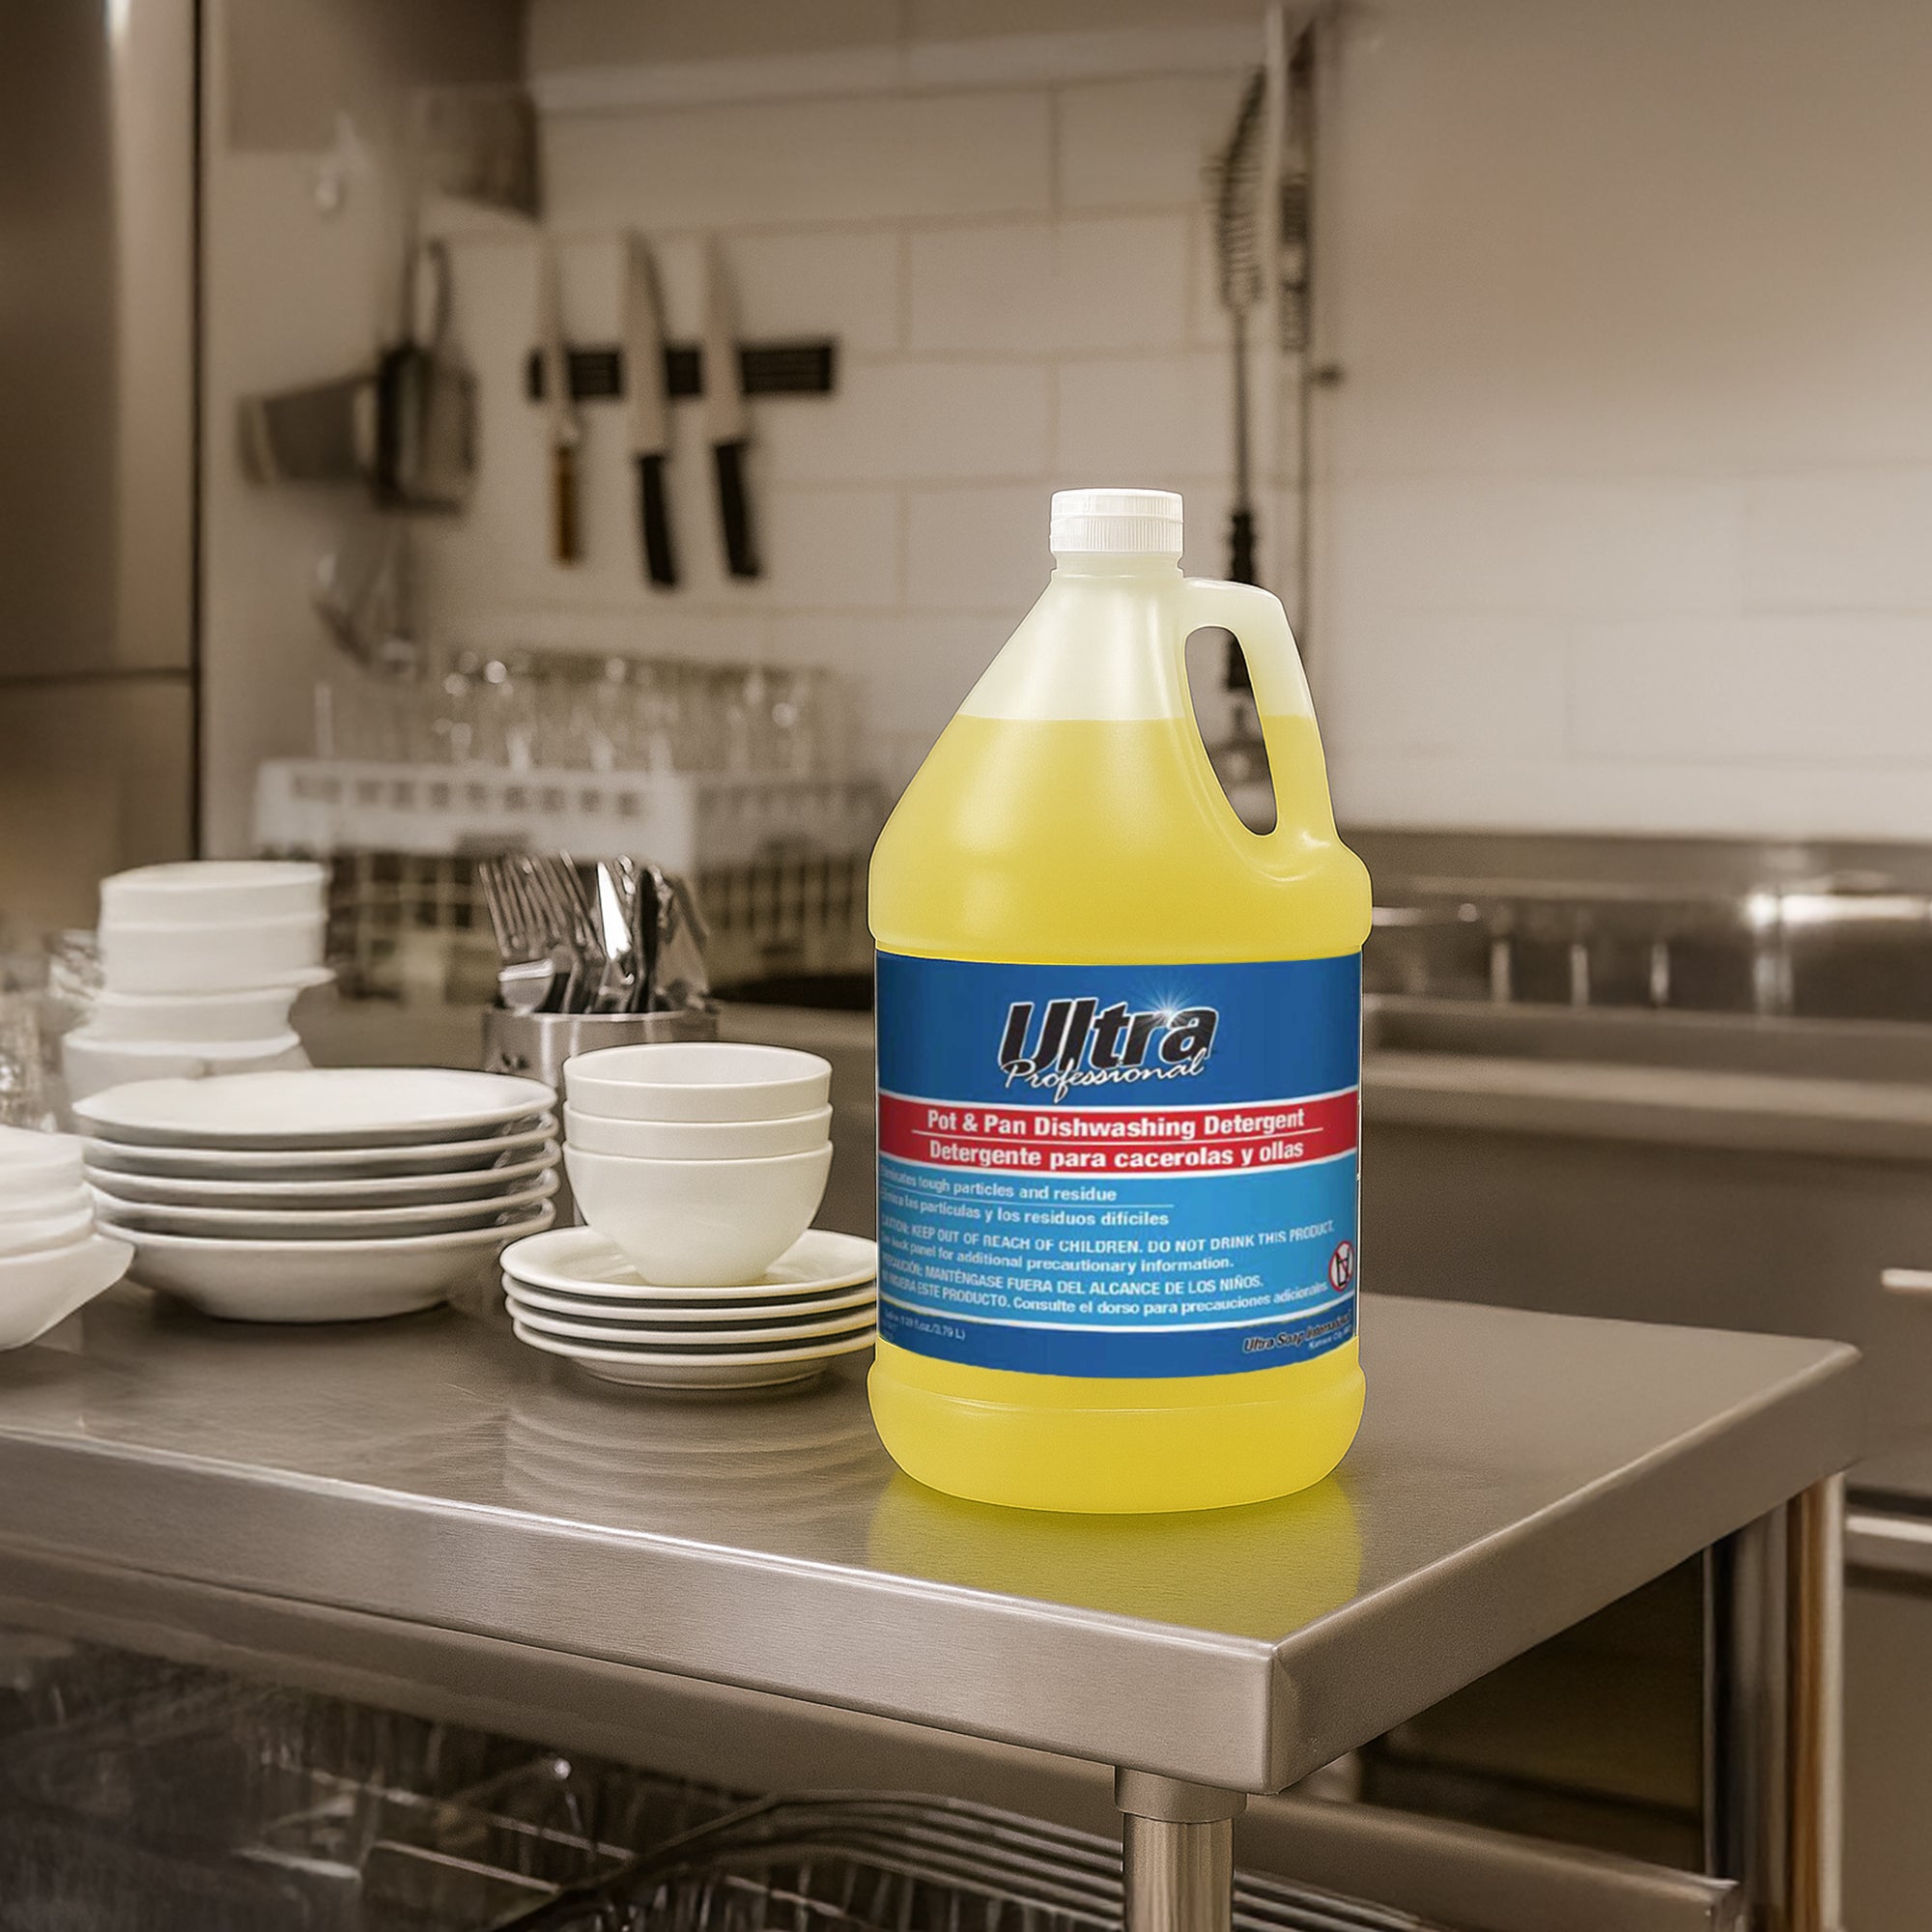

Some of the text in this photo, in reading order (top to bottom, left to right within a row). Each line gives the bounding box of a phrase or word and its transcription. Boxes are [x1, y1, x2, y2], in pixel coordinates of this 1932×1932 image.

[998, 997, 1219, 1074] Ultra
[1001, 1047, 1207, 1103] Professional
[927, 1108, 1304, 1140] Pot & Pan Dishwashing Detergent
[929, 1140, 1304, 1170] Detergente para cacerolas y ollas
[919, 1177, 950, 1193] tough
[952, 1182, 1014, 1198] particles
[1019, 1185, 1049, 1200] and
[1054, 1186, 1118, 1201] residue
[921, 1199, 980, 1219] partículas
[984, 1208, 994, 1223] y
[998, 1207, 1020, 1222] los
[1024, 1210, 1095, 1226] residuos
[1101, 1210, 1169, 1226] difíciles
[911, 1224, 935, 1239] KEEP
[937, 1229, 959, 1242] OUT
[963, 1232, 980, 1244] OF
[983, 1236, 1030, 1250] REACH
[1035, 1237, 1055, 1251] OF
[1059, 1239, 1143, 1253] CHILDREN.
[1148, 1239, 1171, 1253] DO
[1175, 1239, 1206, 1253] NOT
[1210, 1236, 1254, 1251] DRINK
[1258, 1231, 1287, 1245] THIS
[910, 1242, 935, 1256] panel
[938, 1247, 953, 1260] for
[956, 1251, 1023, 1267] additional
[1027, 1258, 1136, 1275] precautionary
[1141, 1257, 1234, 1272] information.
[925, 1264, 1004, 1290] MANTÉNGASE
[1008, 1276, 1053, 1293] FUERA
[1057, 1280, 1085, 1294] DEL
[1089, 1281, 1159, 1295] ALCANCE
[1165, 1281, 1184, 1294] DE
[1188, 1280, 1216, 1294] LOS
[1219, 1275, 1264, 1292] NIÑOS.
[918, 1282, 940, 1297] ESTE
[942, 1287, 1011, 1307] PRODUCTO.
[1013, 1296, 1075, 1313] Consulte
[1079, 1301, 1093, 1313] el
[1096, 1301, 1139, 1314] dorso
[1144, 1302, 1178, 1317] para
[1180, 1293, 1270, 1316] precauciones
[1273, 1281, 1327, 1304] adicionales
[1242, 1336, 1274, 1353] Ultra
